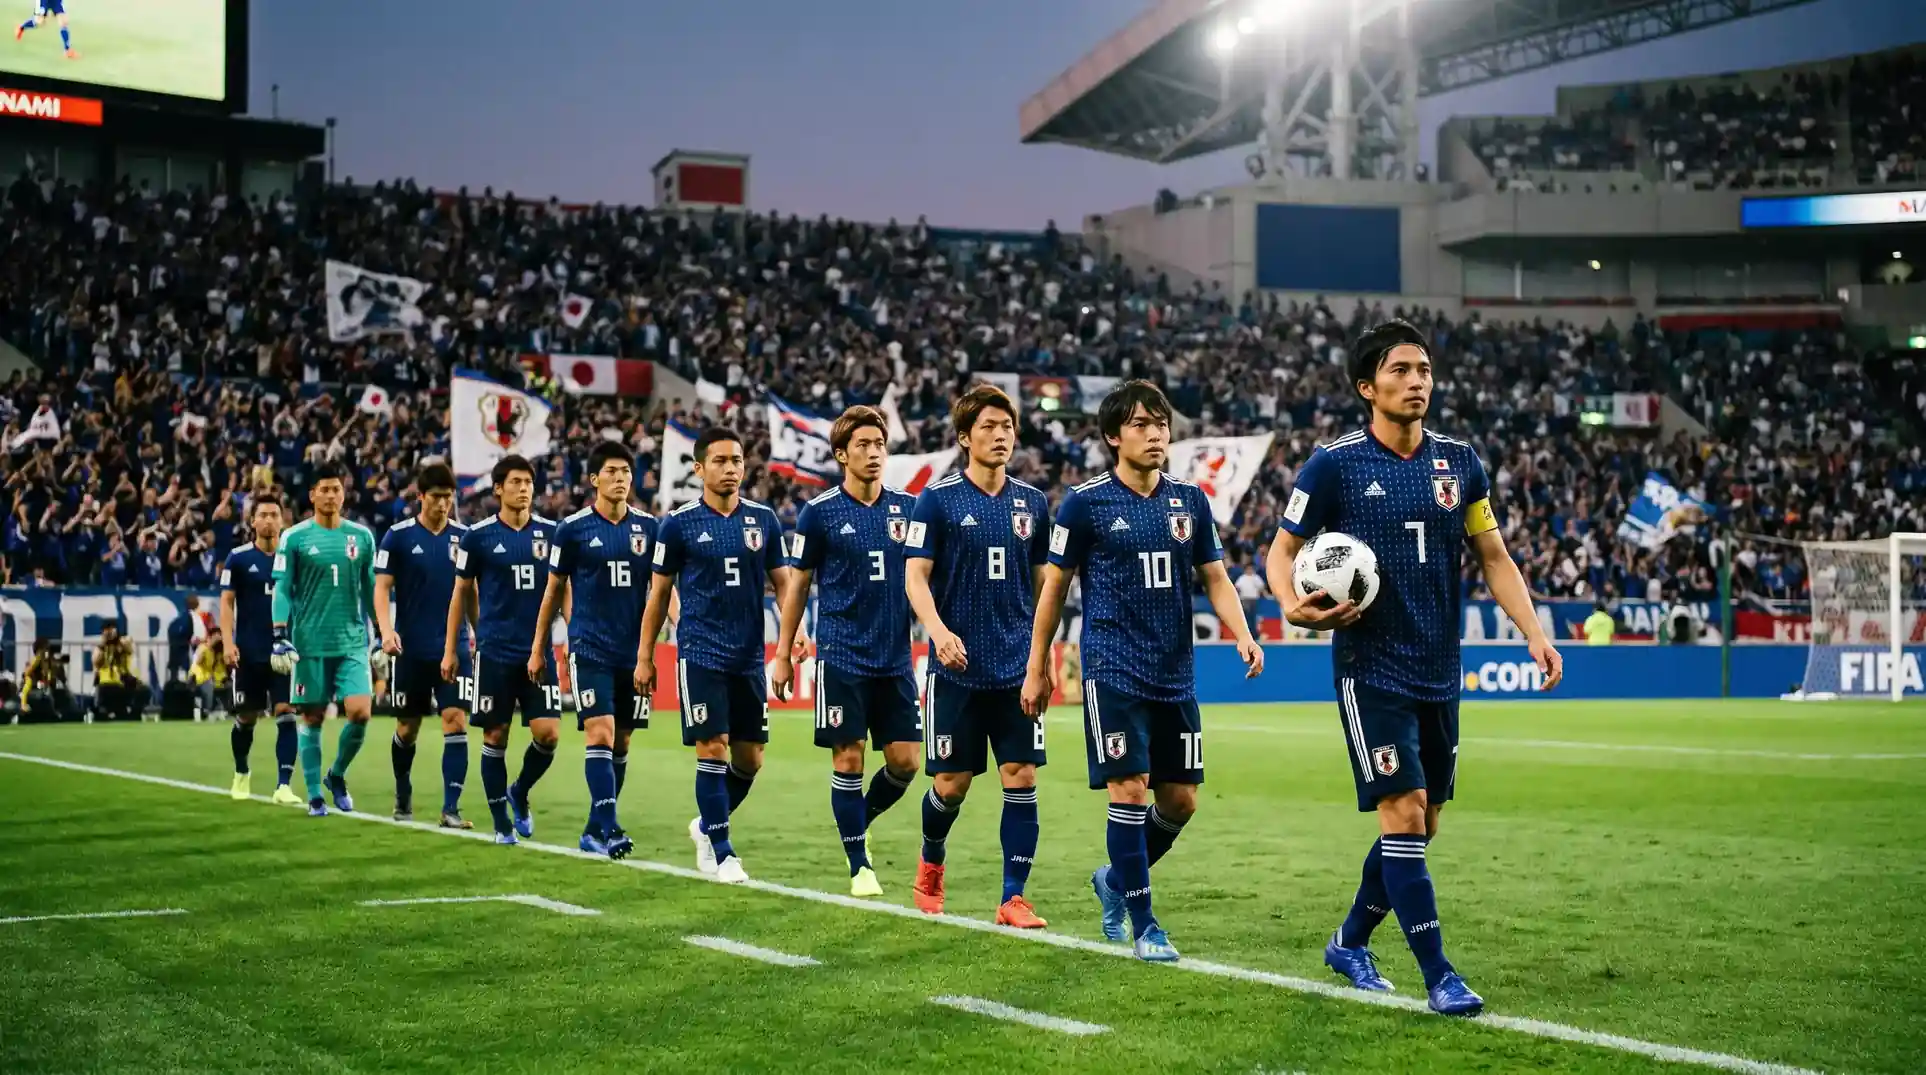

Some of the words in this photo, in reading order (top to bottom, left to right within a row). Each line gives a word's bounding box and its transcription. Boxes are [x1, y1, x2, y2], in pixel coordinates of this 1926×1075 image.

[1405, 521, 1426, 564] 7
[331, 564, 338, 587] 1
[511, 564, 535, 590] 19
[607, 561, 631, 587] 16
[724, 557, 740, 586] 5
[868, 550, 885, 581] 3
[988, 547, 1005, 579] 8
[1138, 551, 1172, 588] 10
[1460, 661, 1549, 692] .com
[1840, 652, 1924, 692] FIFA
[456, 676, 474, 701] 16
[542, 685, 561, 711] 19
[1180, 732, 1204, 770] 10
